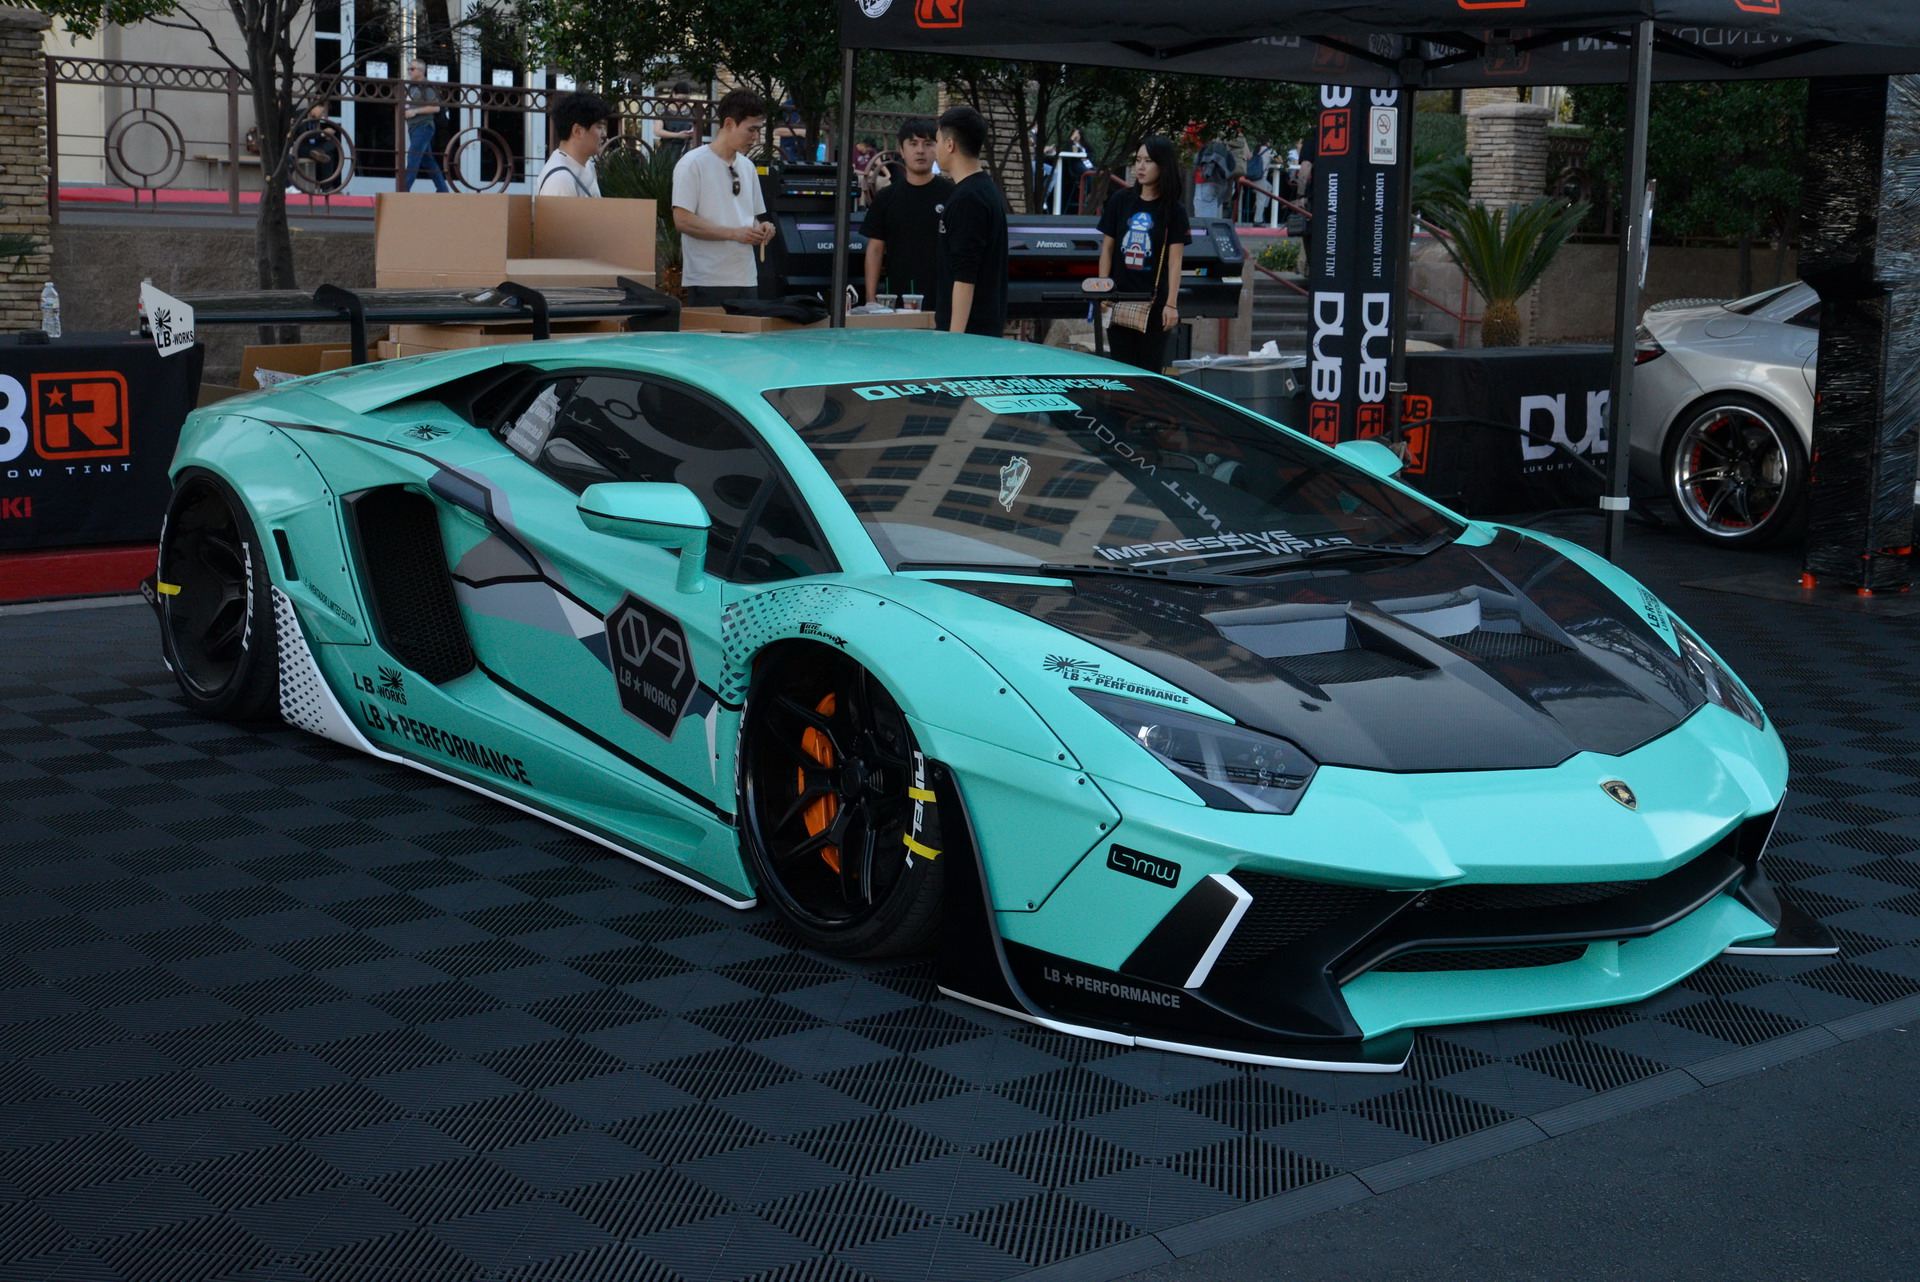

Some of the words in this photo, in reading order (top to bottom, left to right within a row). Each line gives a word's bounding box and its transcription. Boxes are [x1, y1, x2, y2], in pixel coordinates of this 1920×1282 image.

[1328, 173, 1338, 213] LUXURY
[1375, 172, 1385, 213] LUXURY
[1326, 214, 1337, 255] WINDOW
[1373, 214, 1384, 255] WINDOW
[1325, 256, 1336, 278] TINT
[1372, 256, 1382, 278] TINT
[1311, 292, 1344, 401] DUB
[1359, 293, 1390, 402] DUB
[942, 378, 1100, 392] PERFORMANCE
[66, 463, 131, 475] TINT
[1523, 463, 1573, 473] LUXURY
[619, 666, 632, 690] LB
[643, 681, 677, 716] WORKS
[1062, 672, 1080, 682] LB
[1095, 677, 1190, 705] PERFORMANCE
[359, 700, 385, 731] LB
[398, 713, 533, 787] PERFORMANCE
[905, 750, 925, 869] PIELI
[1043, 966, 1061, 983] LB
[1076, 975, 1181, 1008] PERFORMANCE
